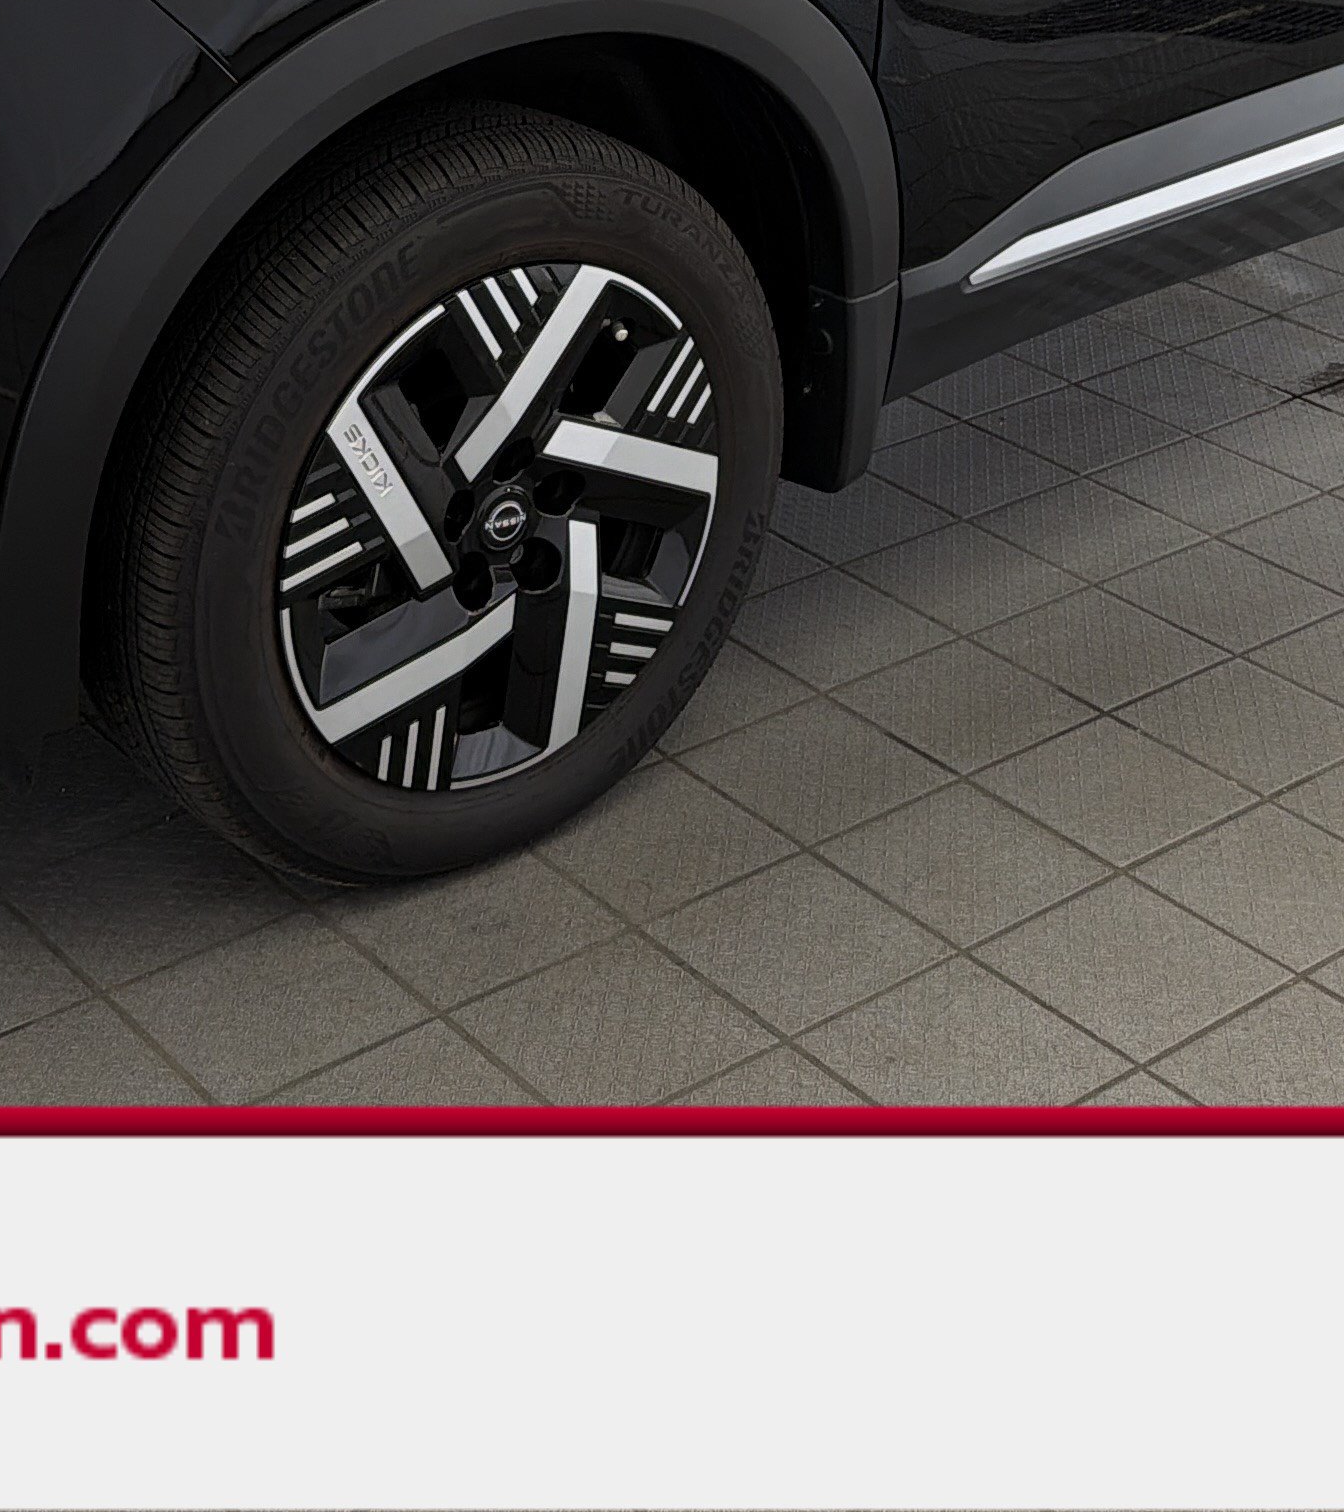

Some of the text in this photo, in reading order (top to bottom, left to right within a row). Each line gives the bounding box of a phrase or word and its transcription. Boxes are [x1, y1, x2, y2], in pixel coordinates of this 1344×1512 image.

[213, 241, 420, 540] BRIDGESTONE
[343, 423, 394, 499] KICKS
[485, 512, 527, 532] NISSAN
